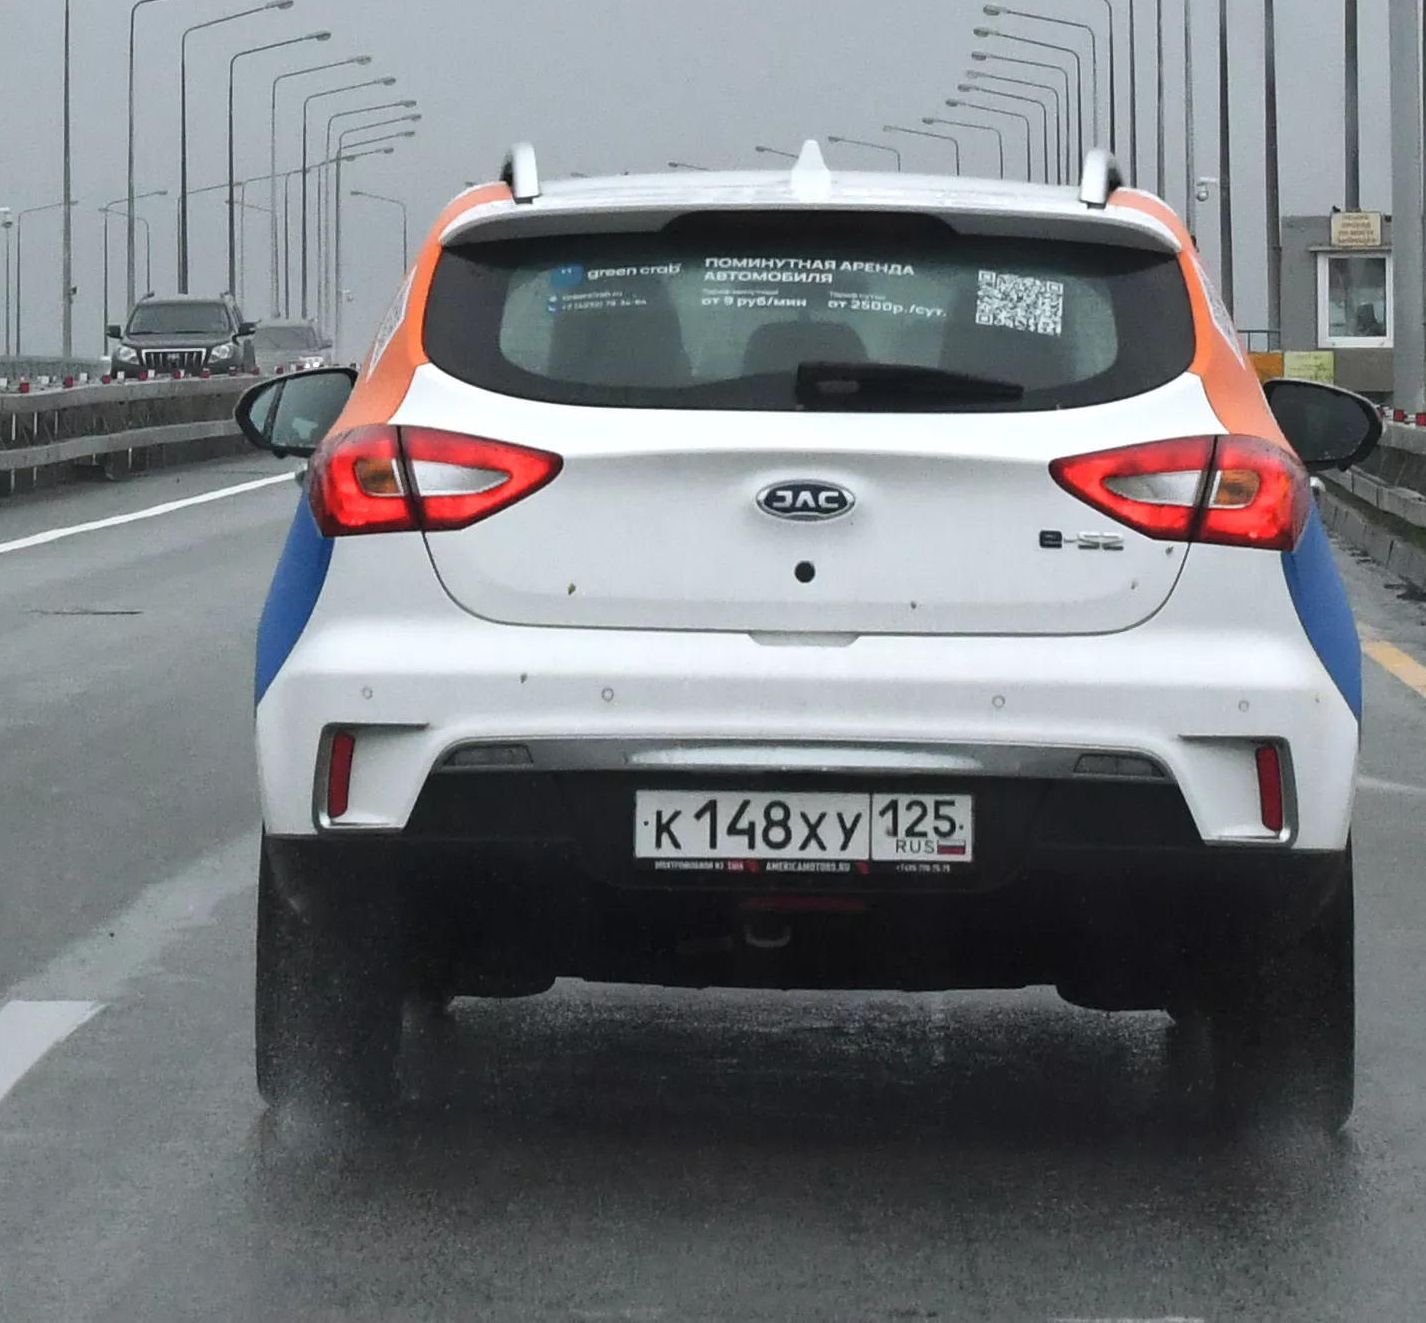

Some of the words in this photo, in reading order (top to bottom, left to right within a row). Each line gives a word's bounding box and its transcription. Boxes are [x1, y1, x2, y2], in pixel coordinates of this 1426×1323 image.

[587, 266, 637, 281] green
[639, 263, 681, 275] crab
[704, 257, 836, 271] ПОМИНУТНАЯ
[839, 261, 915, 276] АРЕНДА
[703, 270, 833, 284] АВТОМОБИЛЯ
[701, 297, 720, 305] от
[737, 296, 807, 307] руб/мин
[827, 300, 847, 308] от
[772, 490, 840, 508] JAC
[878, 799, 957, 839] 125
[895, 839, 936, 855] RUS
